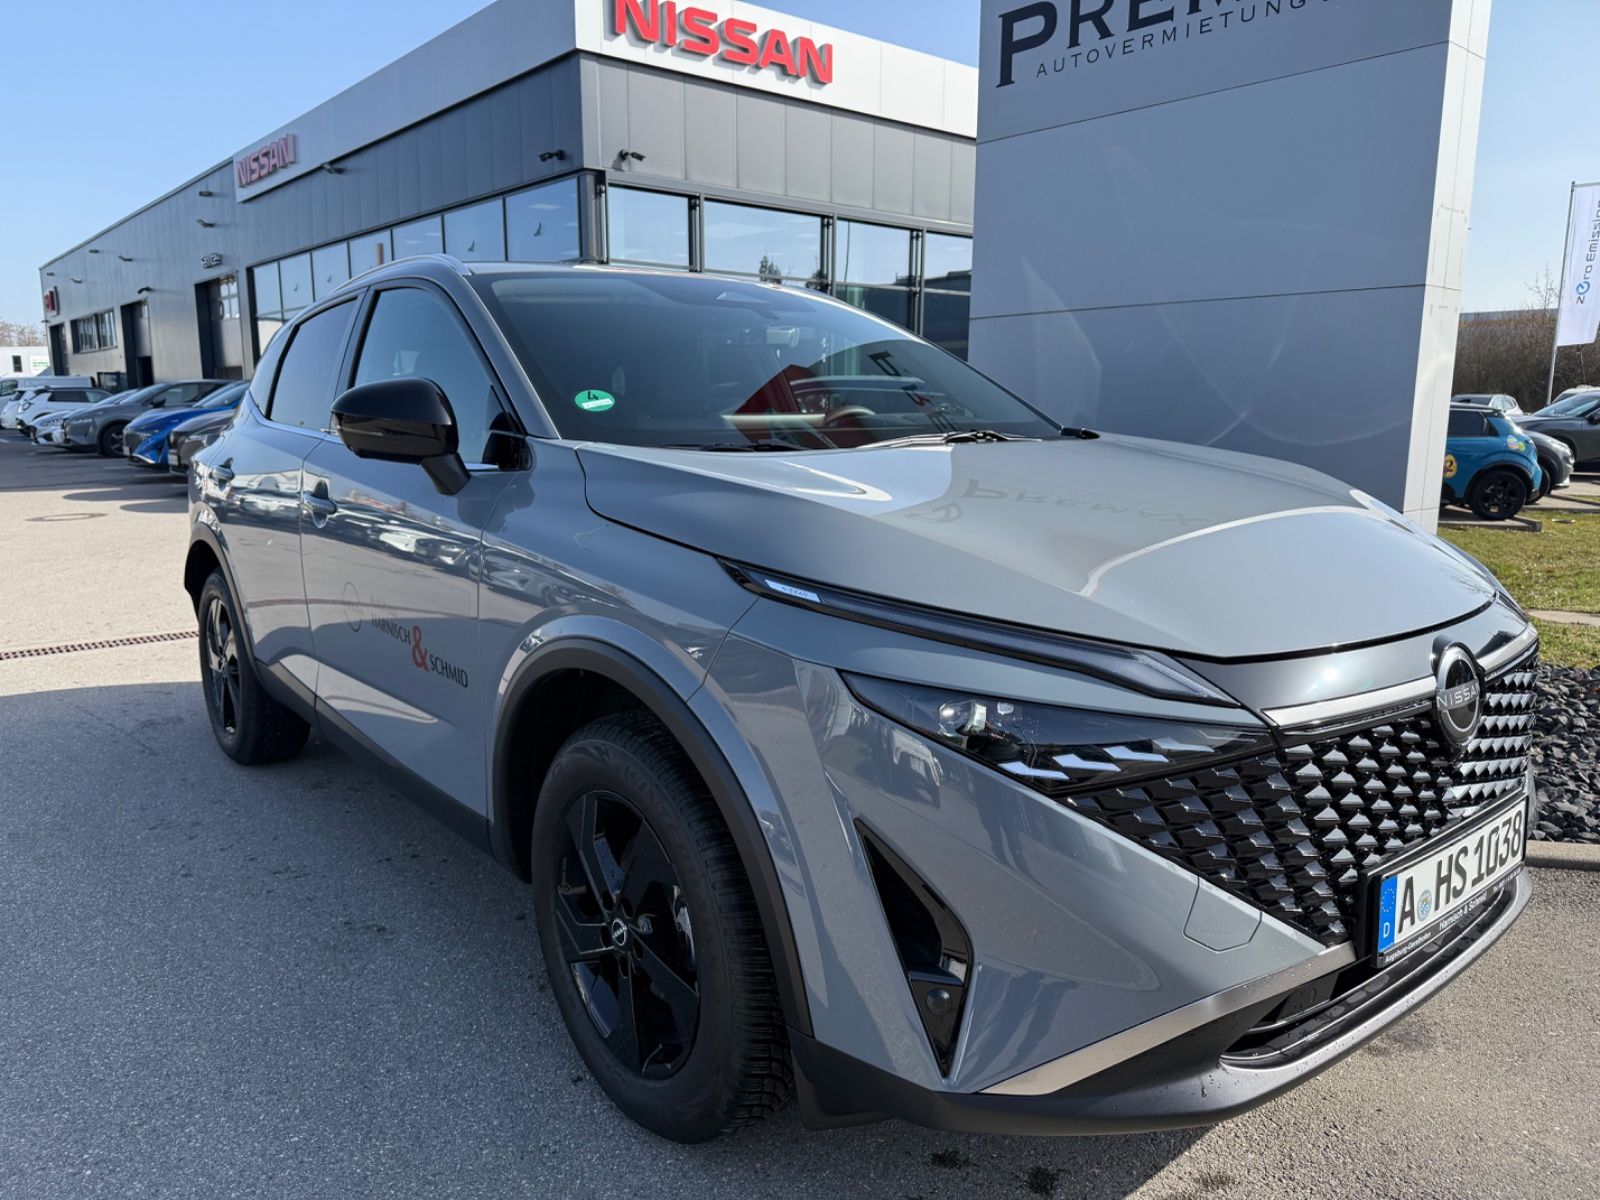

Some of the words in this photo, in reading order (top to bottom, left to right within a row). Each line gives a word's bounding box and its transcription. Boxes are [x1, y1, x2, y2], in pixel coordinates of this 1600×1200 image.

[614, 0, 832, 84] NISSAN
[996, 0, 1239, 88] PRE
[1036, 0, 1305, 78] AUTOVERMIETUNG
[236, 133, 296, 187] NISSAN
[371, 613, 411, 645] HARNISCH
[411, 625, 430, 672] &
[429, 654, 469, 688] SCHMID
[1436, 681, 1480, 710] NISSAN
[1398, 876, 1416, 933] A
[1471, 810, 1522, 888] 1038
[1383, 922, 1390, 938] D
